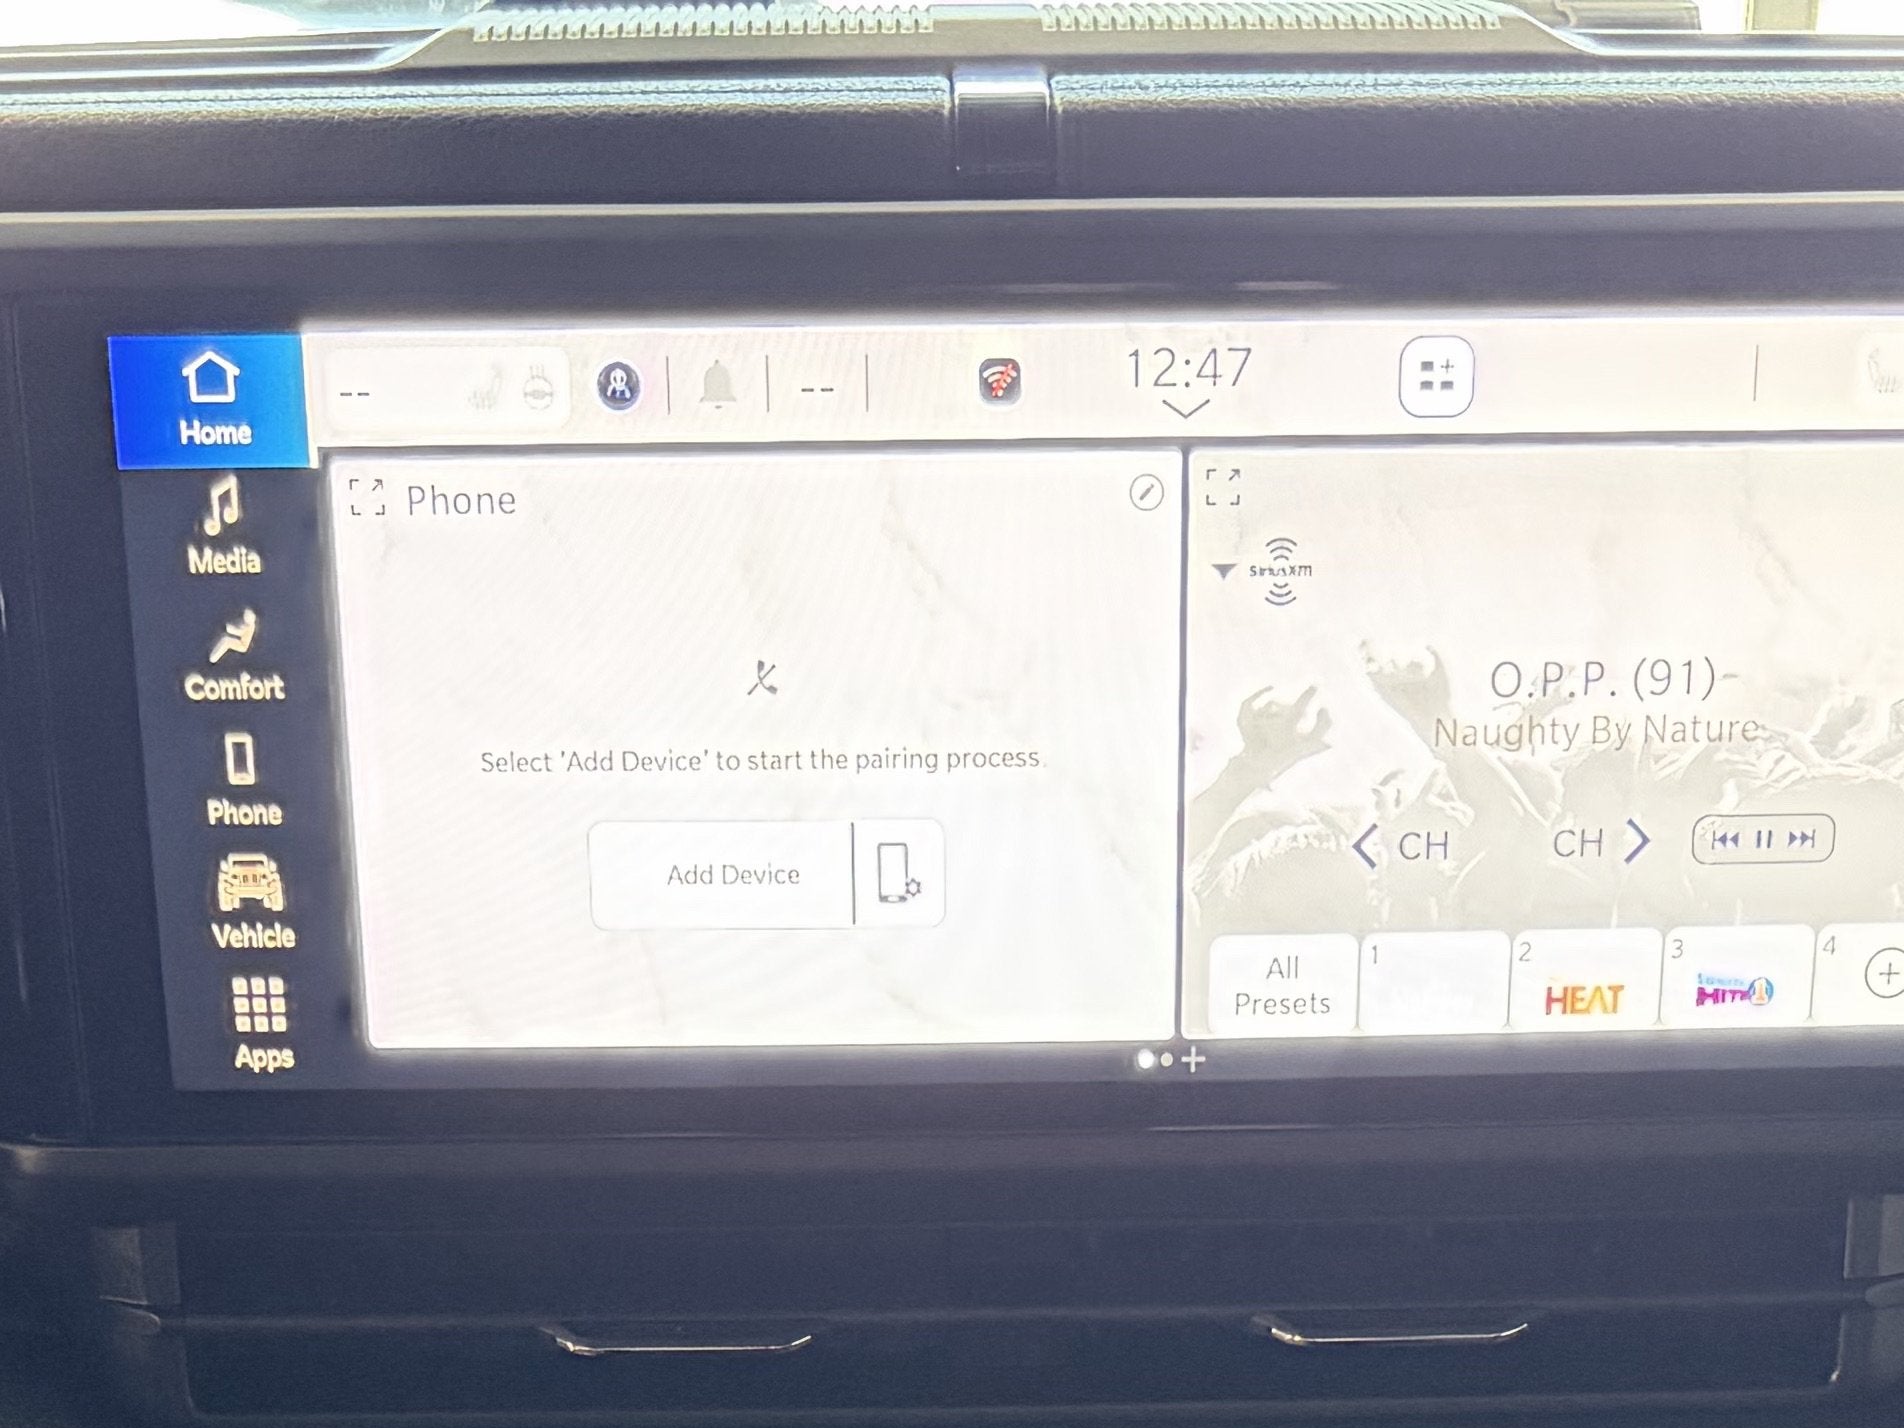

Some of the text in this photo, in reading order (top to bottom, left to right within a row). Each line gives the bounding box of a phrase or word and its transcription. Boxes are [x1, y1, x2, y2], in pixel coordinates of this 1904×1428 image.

[1127, 346, 1252, 389] 12:47
[179, 420, 252, 445] Home
[408, 485, 516, 516] Phone
[188, 547, 261, 574] Media
[184, 673, 286, 701] Comfort
[1490, 658, 1617, 702] O.P.P.
[1433, 714, 1762, 754] Naughty By Nature
[480, 746, 938, 776] Select to start the pairing
[207, 798, 283, 825] Phone
[1398, 831, 1449, 860] CH
[1553, 829, 1603, 859] CH
[666, 861, 801, 885] Add Device
[211, 923, 296, 948] Vehicle
[1671, 938, 1684, 959] 3
[1822, 935, 1836, 955] 4
[1518, 940, 1533, 962] 2
[1266, 955, 1301, 982] All
[1235, 989, 1332, 1019] Presets
[1545, 983, 1626, 1017] HEAT
[234, 1044, 295, 1072] Apps
